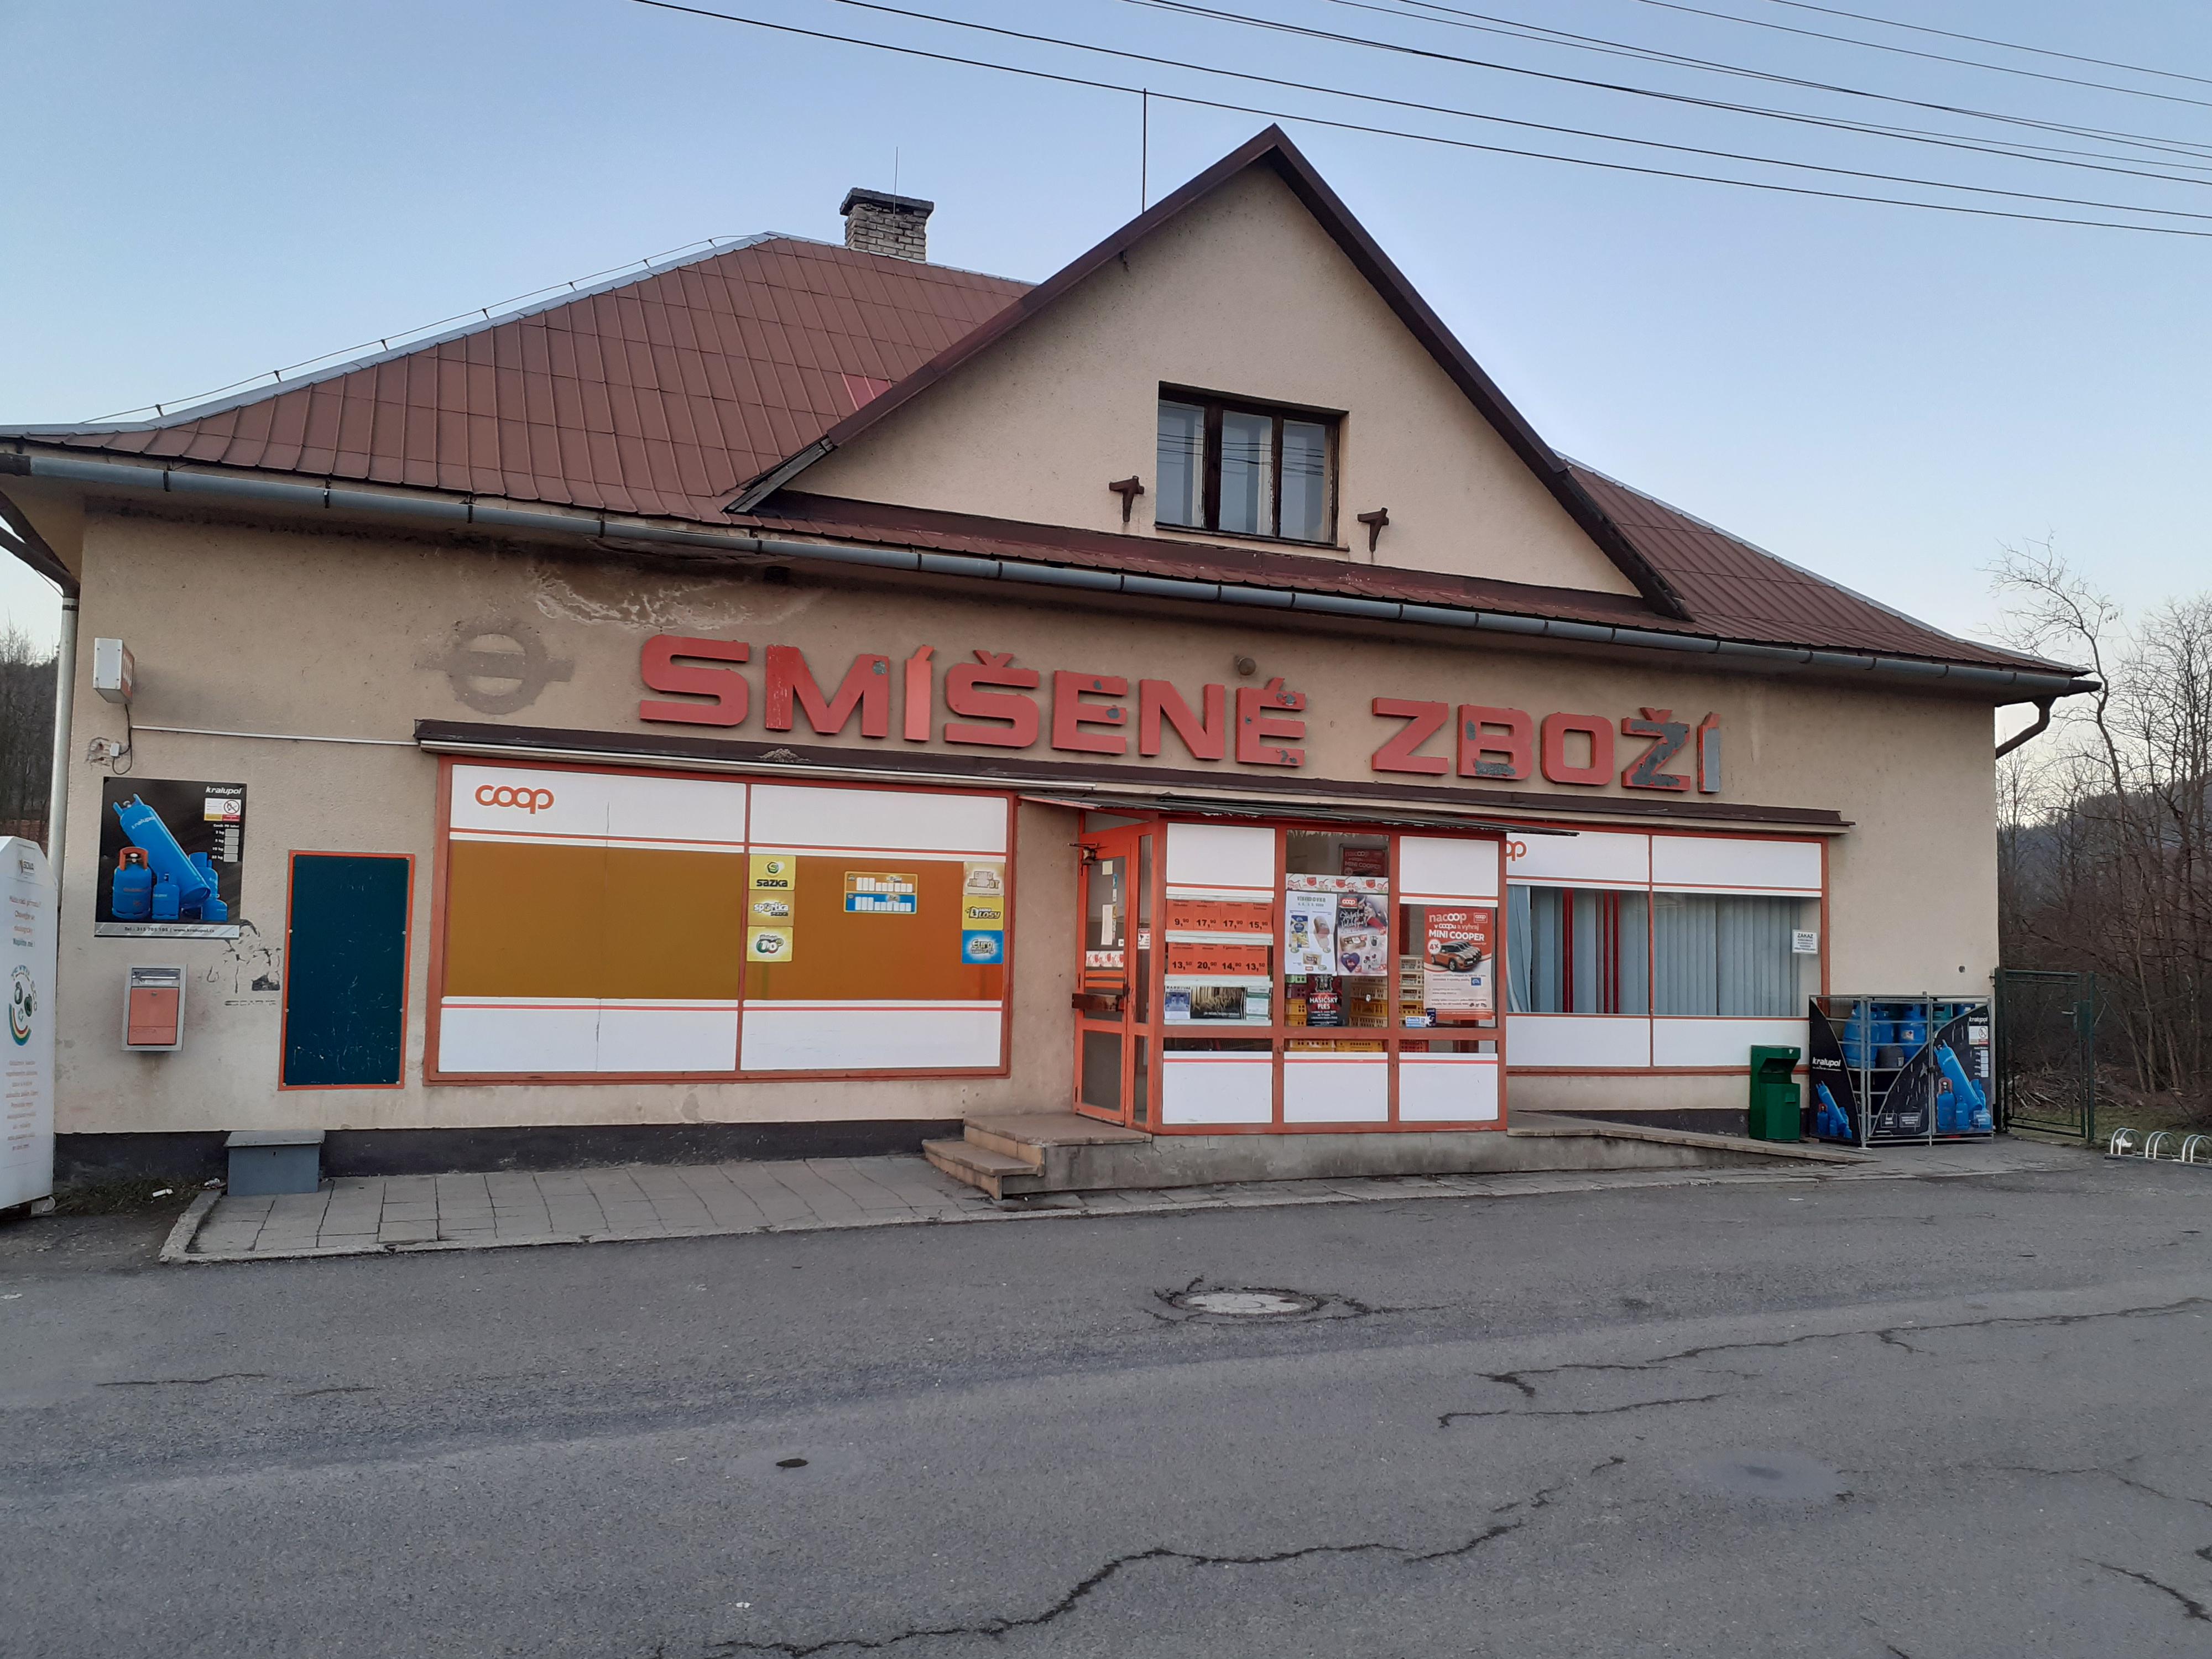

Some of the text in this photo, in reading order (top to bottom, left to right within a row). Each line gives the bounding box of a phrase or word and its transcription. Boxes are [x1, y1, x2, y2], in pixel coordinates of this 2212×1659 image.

[639, 634, 1720, 793] SMÍŠENÉ ZBOŽÍ
[205, 786, 242, 795] kralupol
[475, 785, 554, 814] coop
[754, 902, 789, 912] sportka
[1429, 912, 1467, 924] nacoop
[1429, 930, 1484, 941] MINI COOPER
[1812, 1057, 1841, 1068] kralupol
